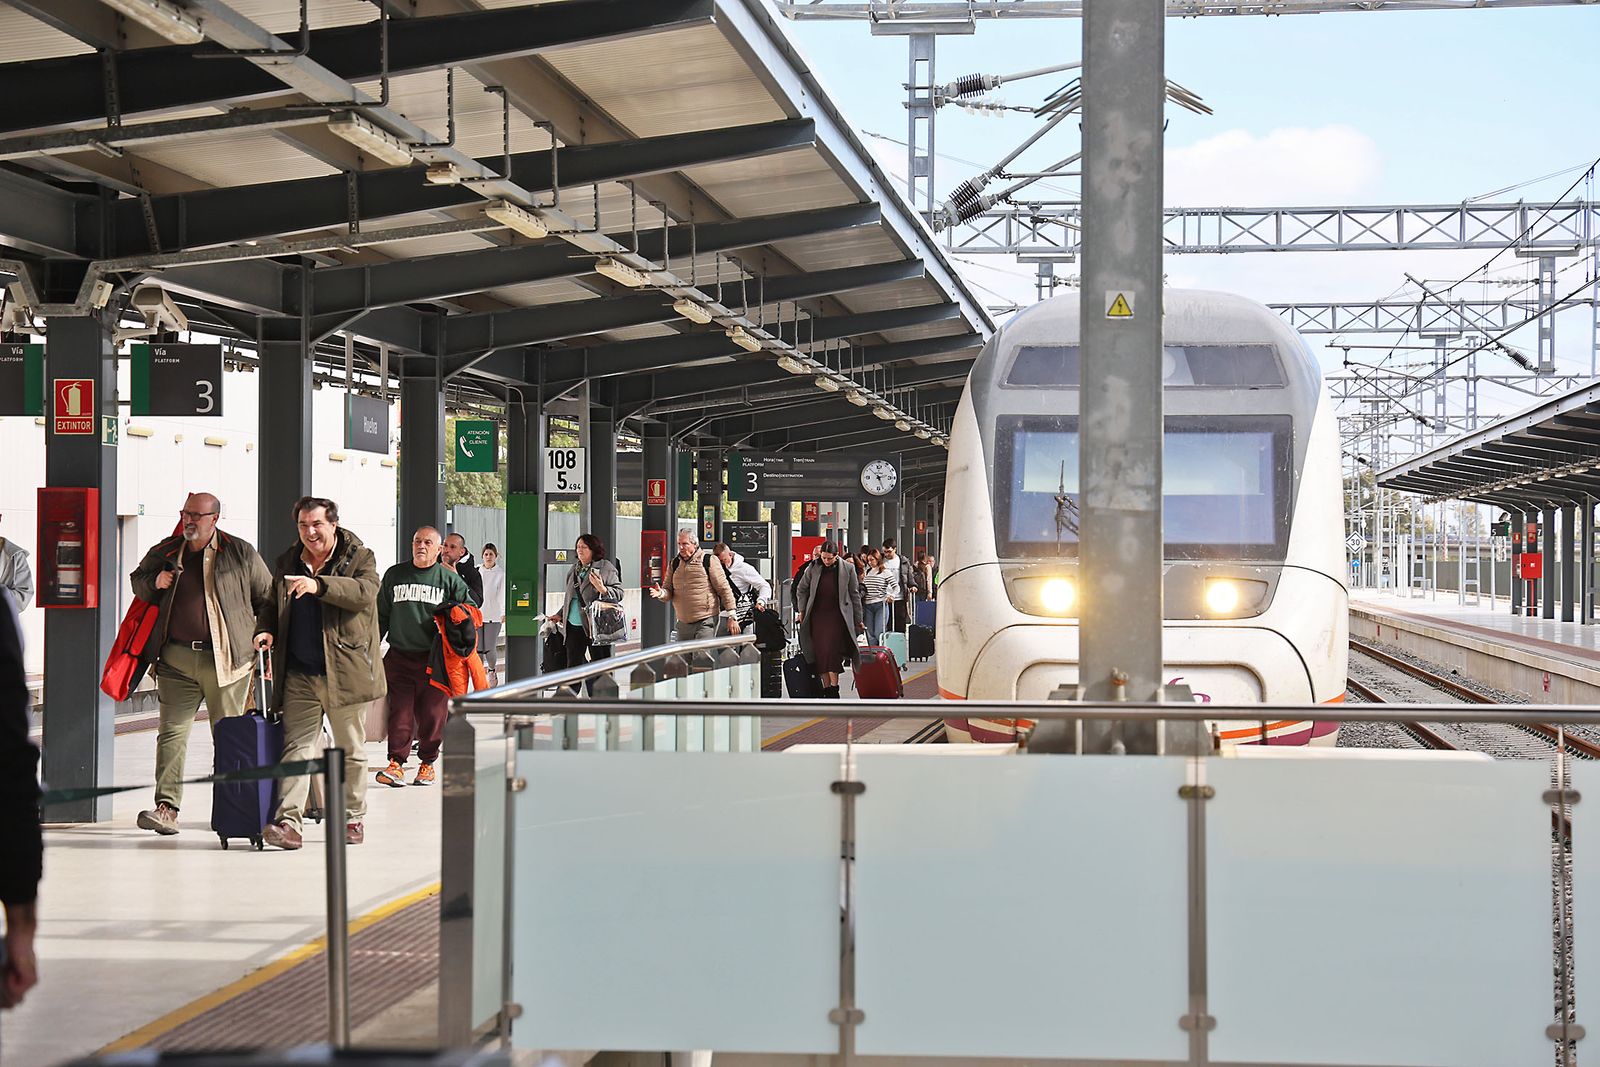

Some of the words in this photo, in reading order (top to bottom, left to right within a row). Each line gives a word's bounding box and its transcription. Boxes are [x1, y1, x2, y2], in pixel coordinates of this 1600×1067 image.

[11, 346, 24, 355] Vía
[154, 347, 167, 356] Vía
[195, 380, 214, 413] 3
[57, 421, 91, 430] EXTINTOR
[548, 450, 577, 469] 108
[557, 471, 568, 490] 5
[746, 472, 758, 492] 3
[1350, 538, 1361, 546] 30
[393, 583, 444, 605] BIRMINGHAM
